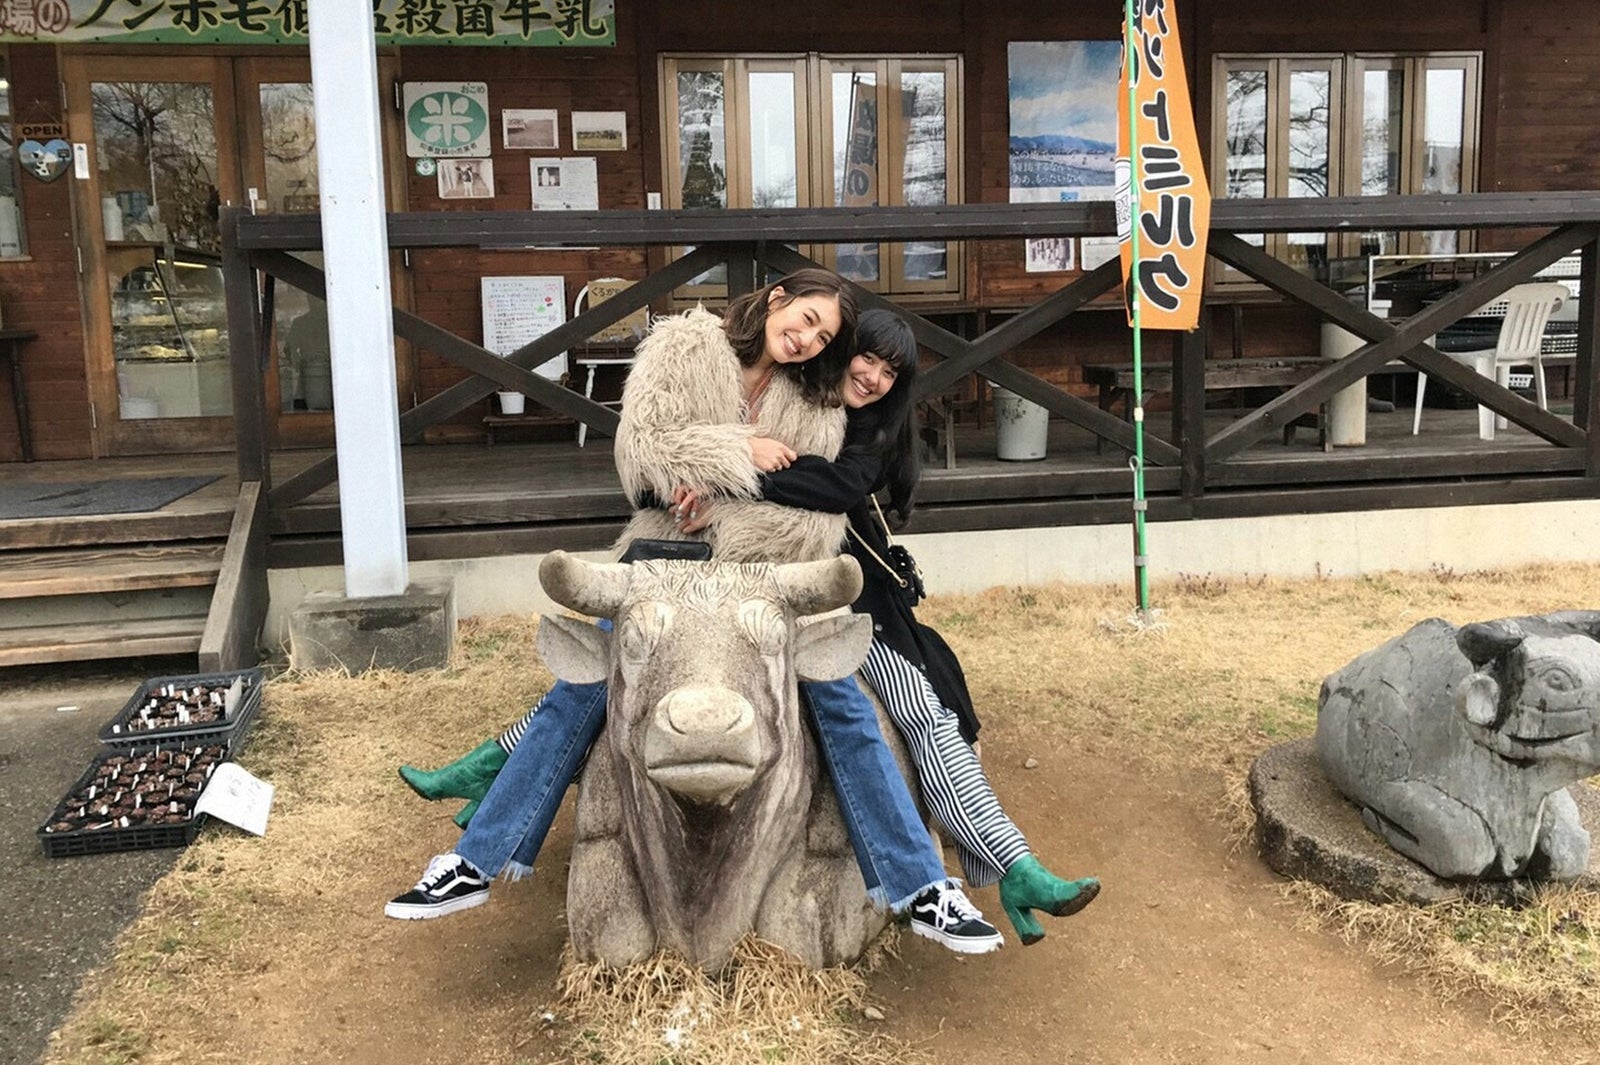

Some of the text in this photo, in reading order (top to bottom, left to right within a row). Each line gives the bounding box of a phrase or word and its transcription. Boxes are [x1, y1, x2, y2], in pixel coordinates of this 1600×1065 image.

[0, 0, 70, 35] 場の
[75, 0, 606, 37] ノンホモ低殺菌牛乳
[461, 85, 485, 94] おこめ
[22, 126, 63, 135] OPEN
